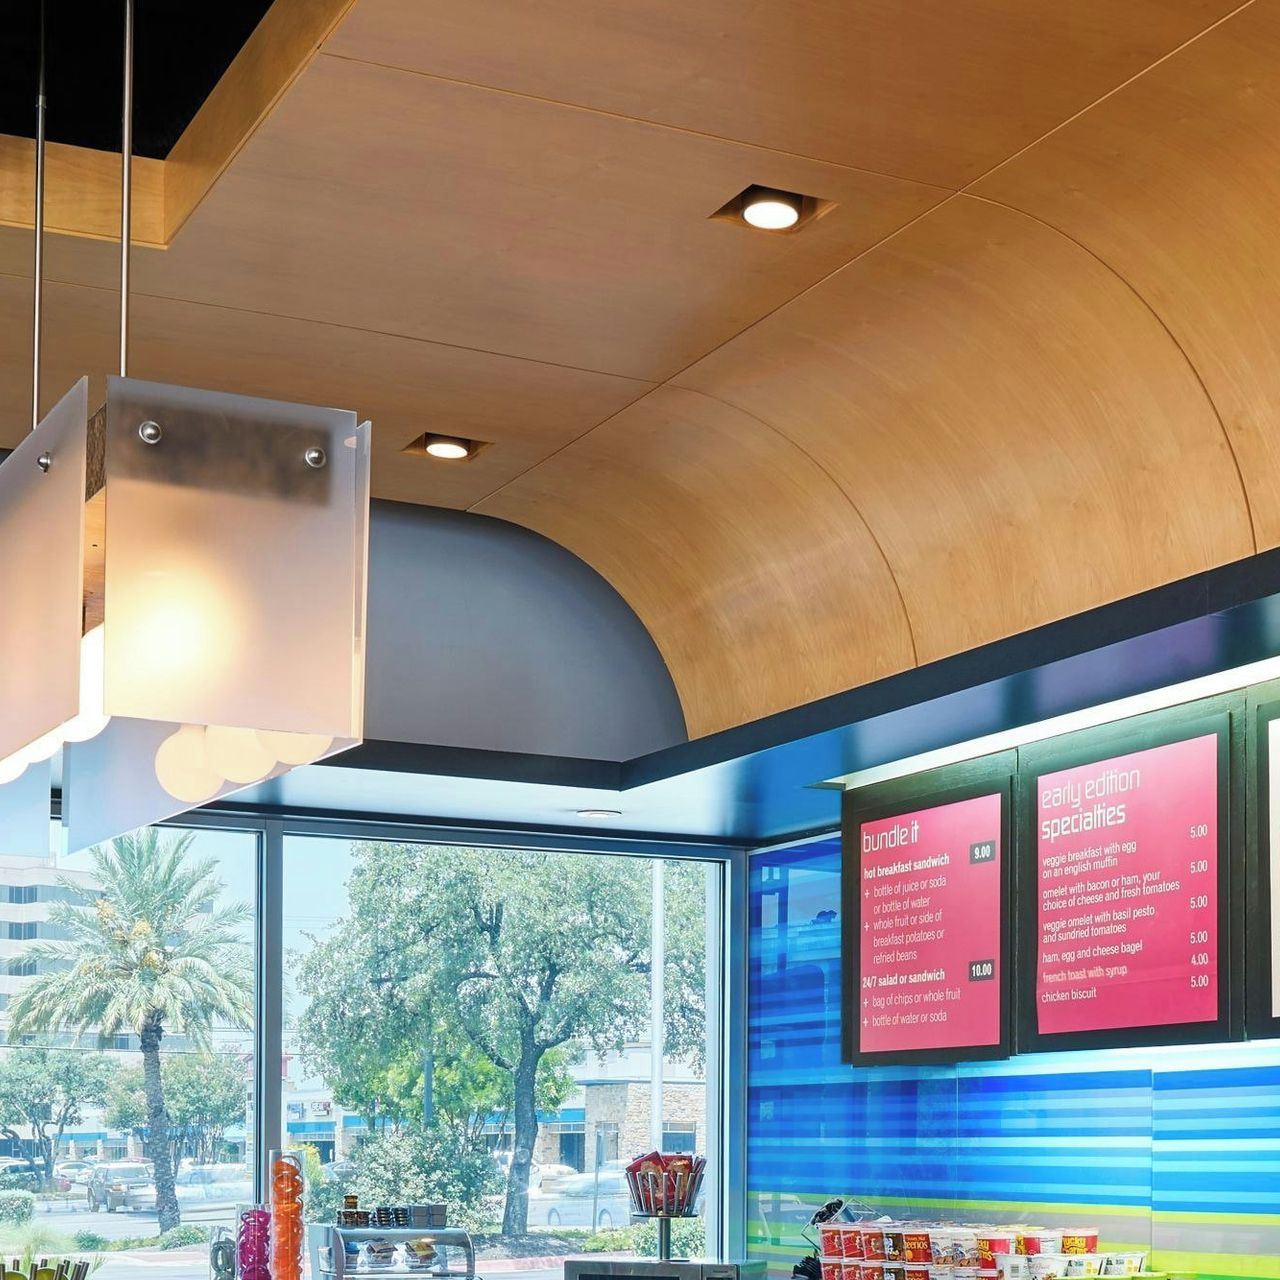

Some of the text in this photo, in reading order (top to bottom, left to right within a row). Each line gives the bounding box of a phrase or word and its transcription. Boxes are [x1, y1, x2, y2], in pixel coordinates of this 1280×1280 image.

[1041, 767, 1140, 809] early edition
[1041, 803, 1126, 841] specialties
[863, 820, 919, 853] bundle it
[974, 844, 990, 859] 9.00
[1042, 841, 1136, 868] veggie breakfast with egg
[863, 852, 950, 879] hot breakfast sandwich
[1042, 855, 1118, 879] on an english muffin
[878, 973, 898, 986] salad
[899, 974, 907, 984] or
[908, 968, 945, 983] sandwich
[972, 963, 992, 977] 10.00
